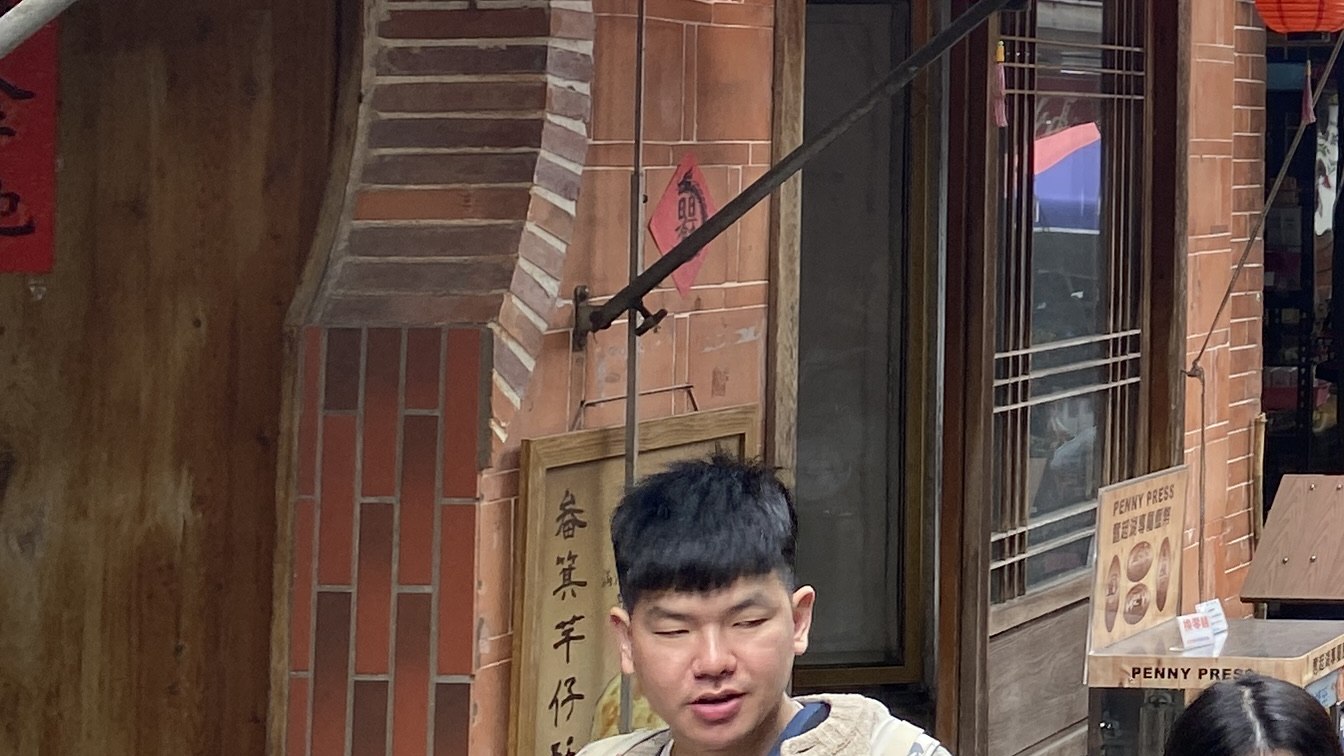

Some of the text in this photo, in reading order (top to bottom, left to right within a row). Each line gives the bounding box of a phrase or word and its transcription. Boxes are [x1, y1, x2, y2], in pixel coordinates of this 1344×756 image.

[1112, 484, 1175, 517] PENNY PRESS
[1131, 667, 1191, 680] PENNY
